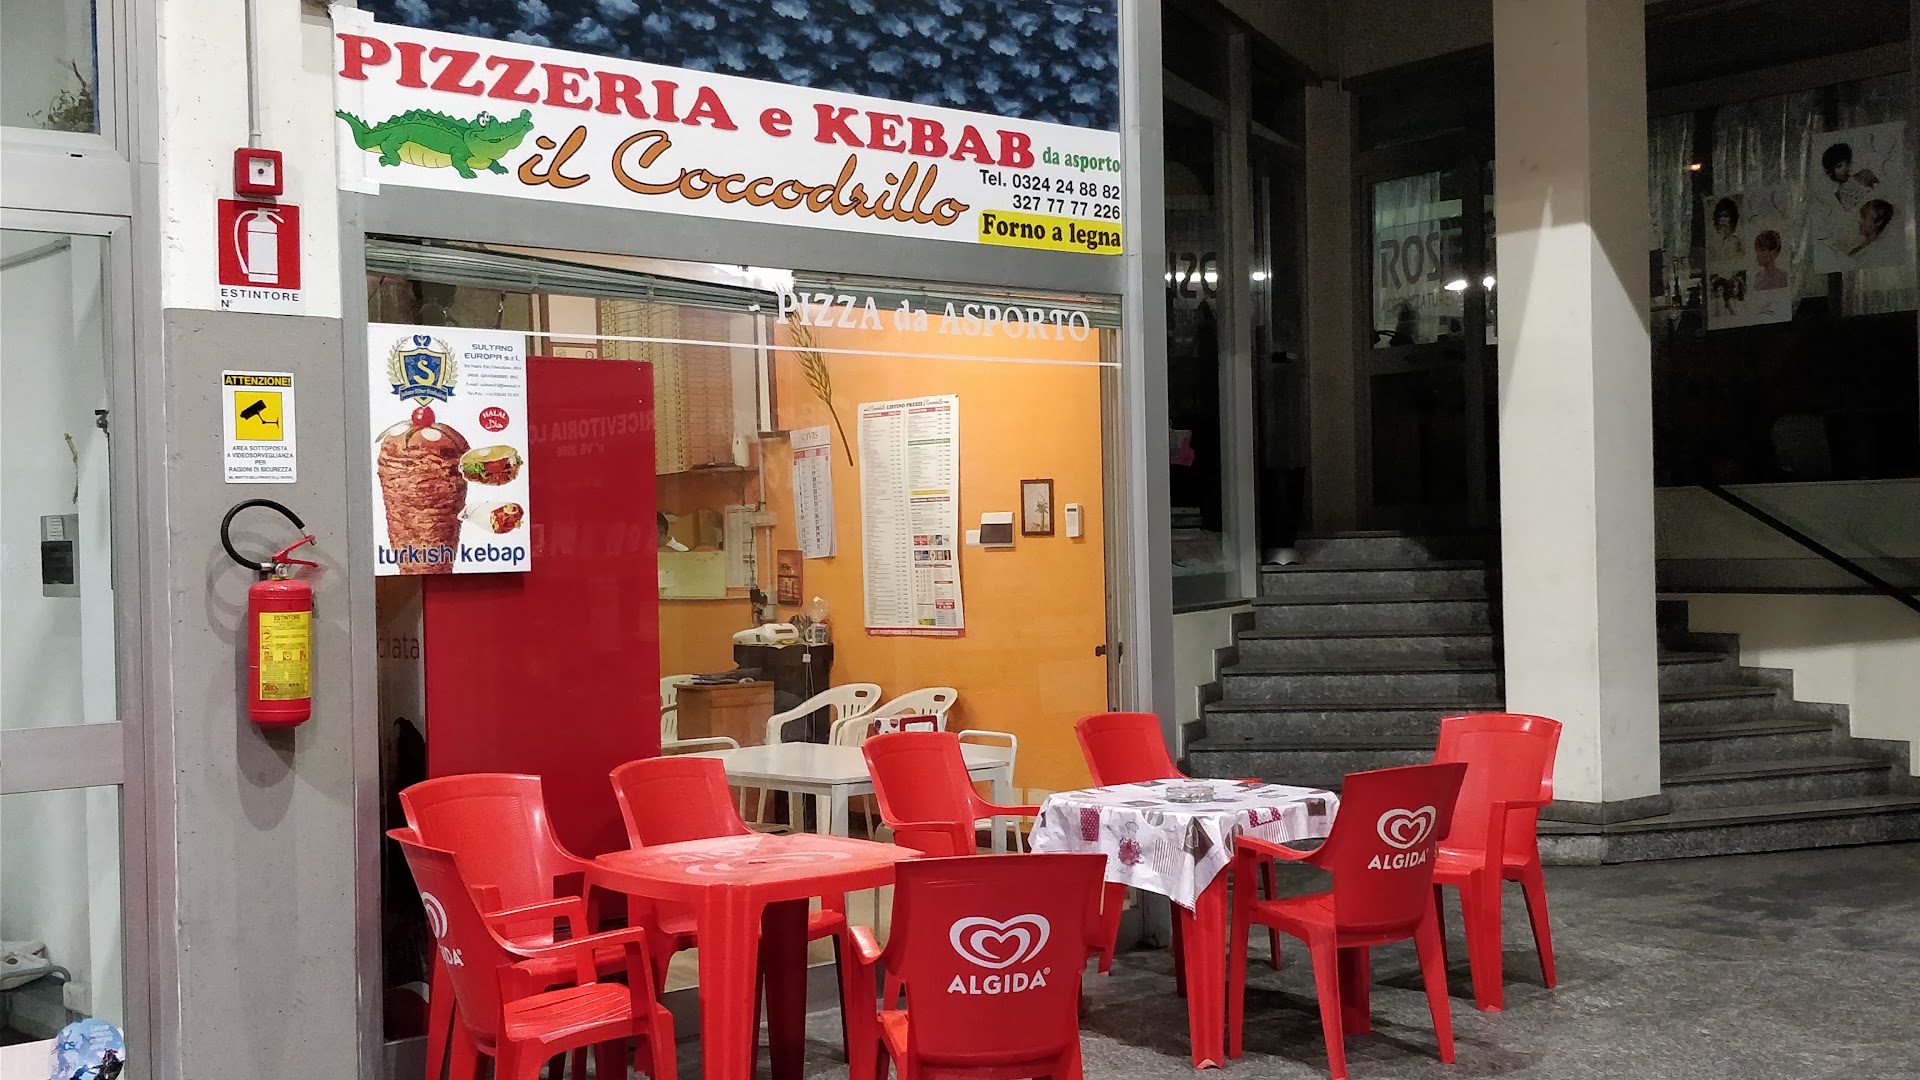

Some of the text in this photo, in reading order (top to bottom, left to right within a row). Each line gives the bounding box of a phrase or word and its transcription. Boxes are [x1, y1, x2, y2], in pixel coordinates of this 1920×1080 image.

[335, 32, 1036, 169] PIZZERIA e KEBAB
[1042, 146, 1121, 174] da asporto
[517, 125, 970, 227] il Coccodrillo
[979, 169, 1121, 200] Tel. 0324 24 88 82
[1013, 194, 1121, 219] 327 77 77 226
[982, 213, 1122, 250] Forno a legna
[220, 288, 300, 302] ESTINTORE
[777, 290, 1090, 342] PIZZA da ASPORTO
[464, 352, 502, 360] EUROPA
[471, 344, 513, 352] SULTANO
[225, 375, 292, 387] ATTENZIONE!
[482, 410, 506, 420] HALAL
[378, 543, 526, 566] turkish kebap
[1367, 849, 1426, 870] ALGIDA
[947, 969, 1047, 995] ALGIDA
